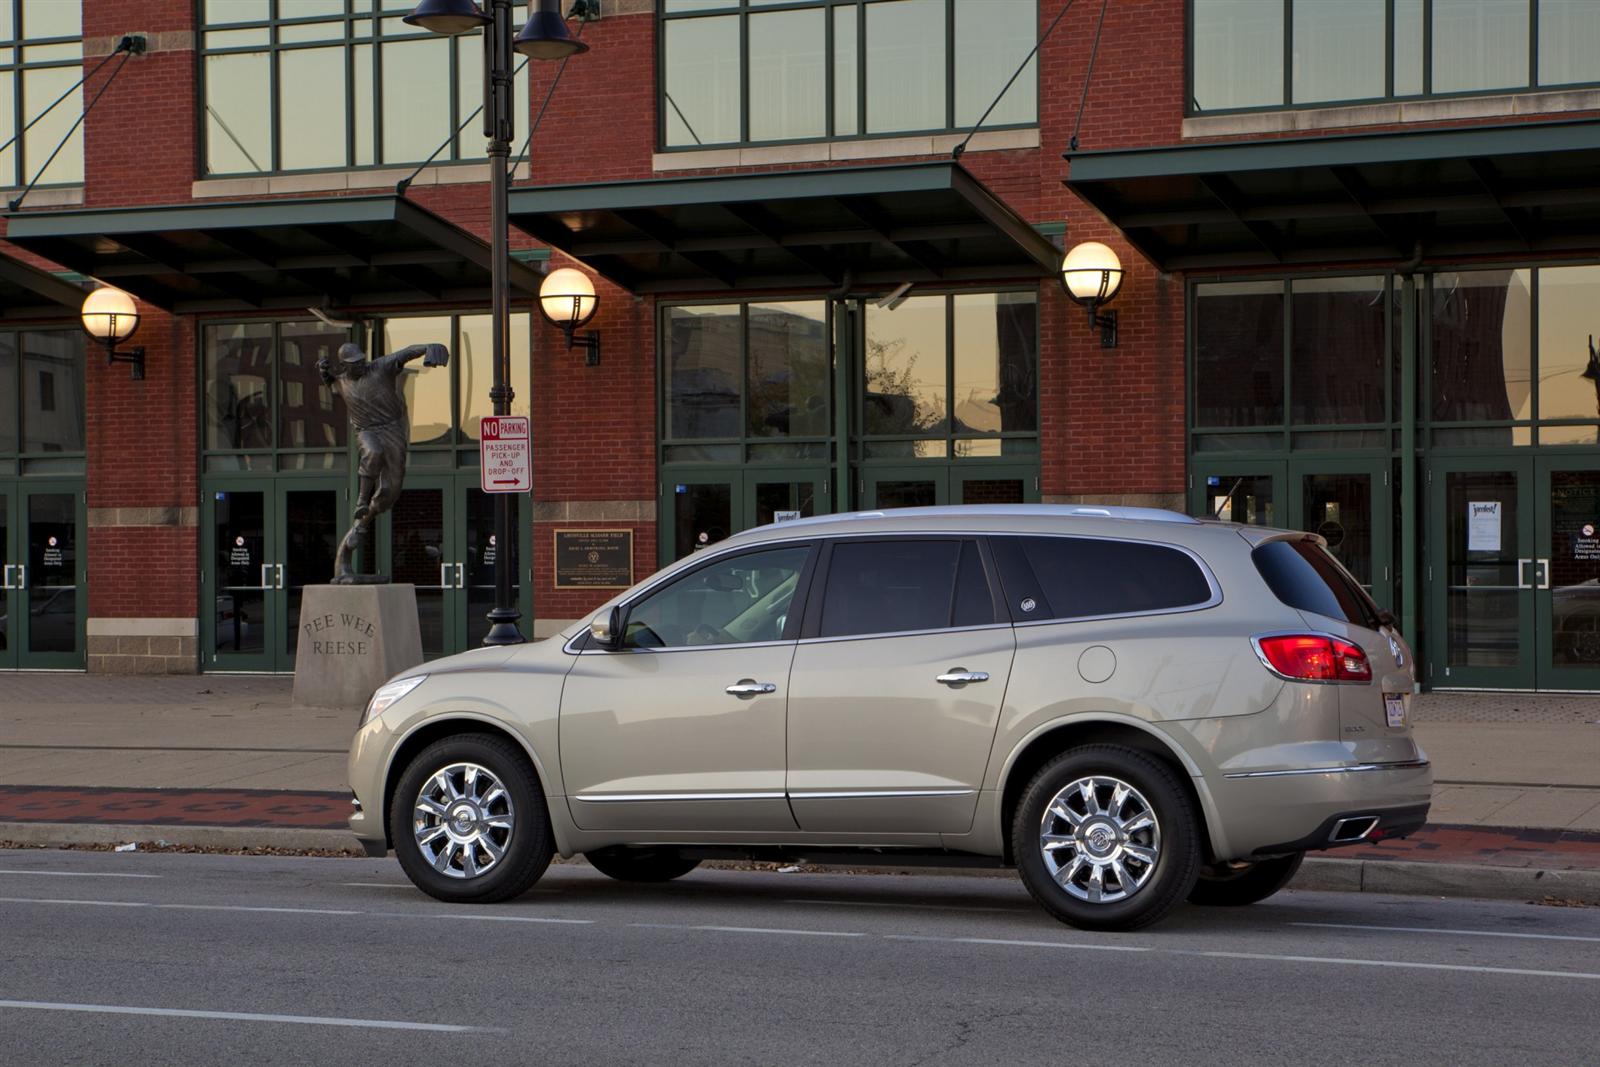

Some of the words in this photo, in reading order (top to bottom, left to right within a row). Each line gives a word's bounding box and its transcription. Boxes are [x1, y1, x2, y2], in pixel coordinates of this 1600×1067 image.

[483, 422, 498, 436] NO
[500, 423, 526, 434] PARKING
[488, 467, 525, 475] DROP-OFF
[304, 614, 334, 638] PEE
[340, 613, 376, 638] WEE
[313, 641, 367, 655] REESE
